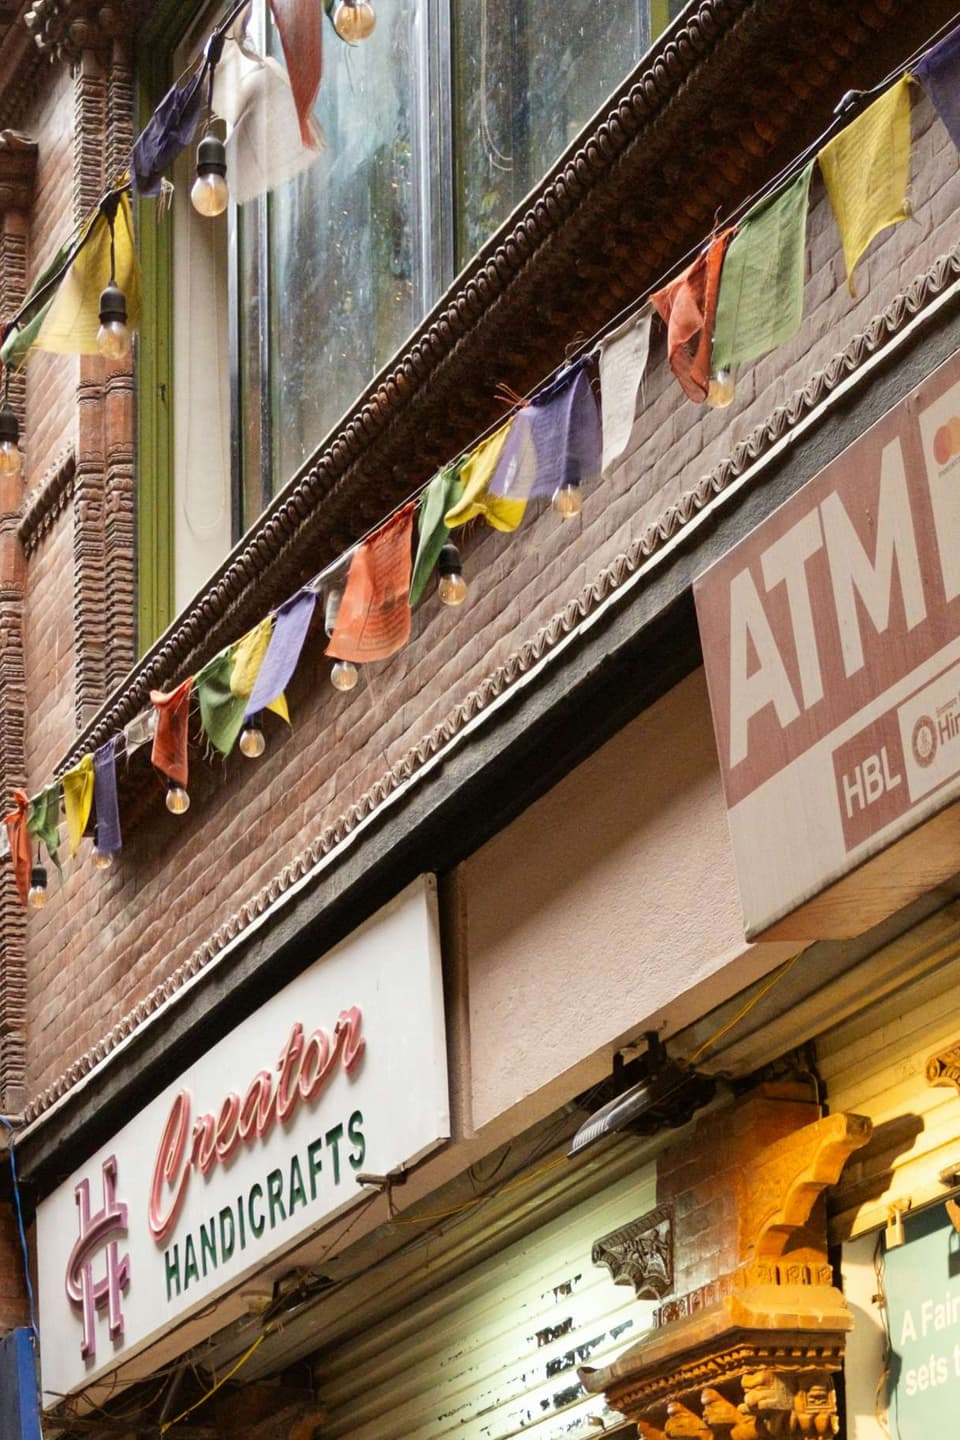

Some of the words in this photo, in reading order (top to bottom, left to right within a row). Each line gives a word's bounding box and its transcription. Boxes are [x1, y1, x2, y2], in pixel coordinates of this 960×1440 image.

[729, 436, 928, 770] ATM
[843, 746, 901, 818] HBL
[148, 1005, 368, 1243] Creator
[164, 1110, 367, 1303] HANDICRAFTS
[900, 1309, 917, 1347] A
[905, 1353, 948, 1397] sets
